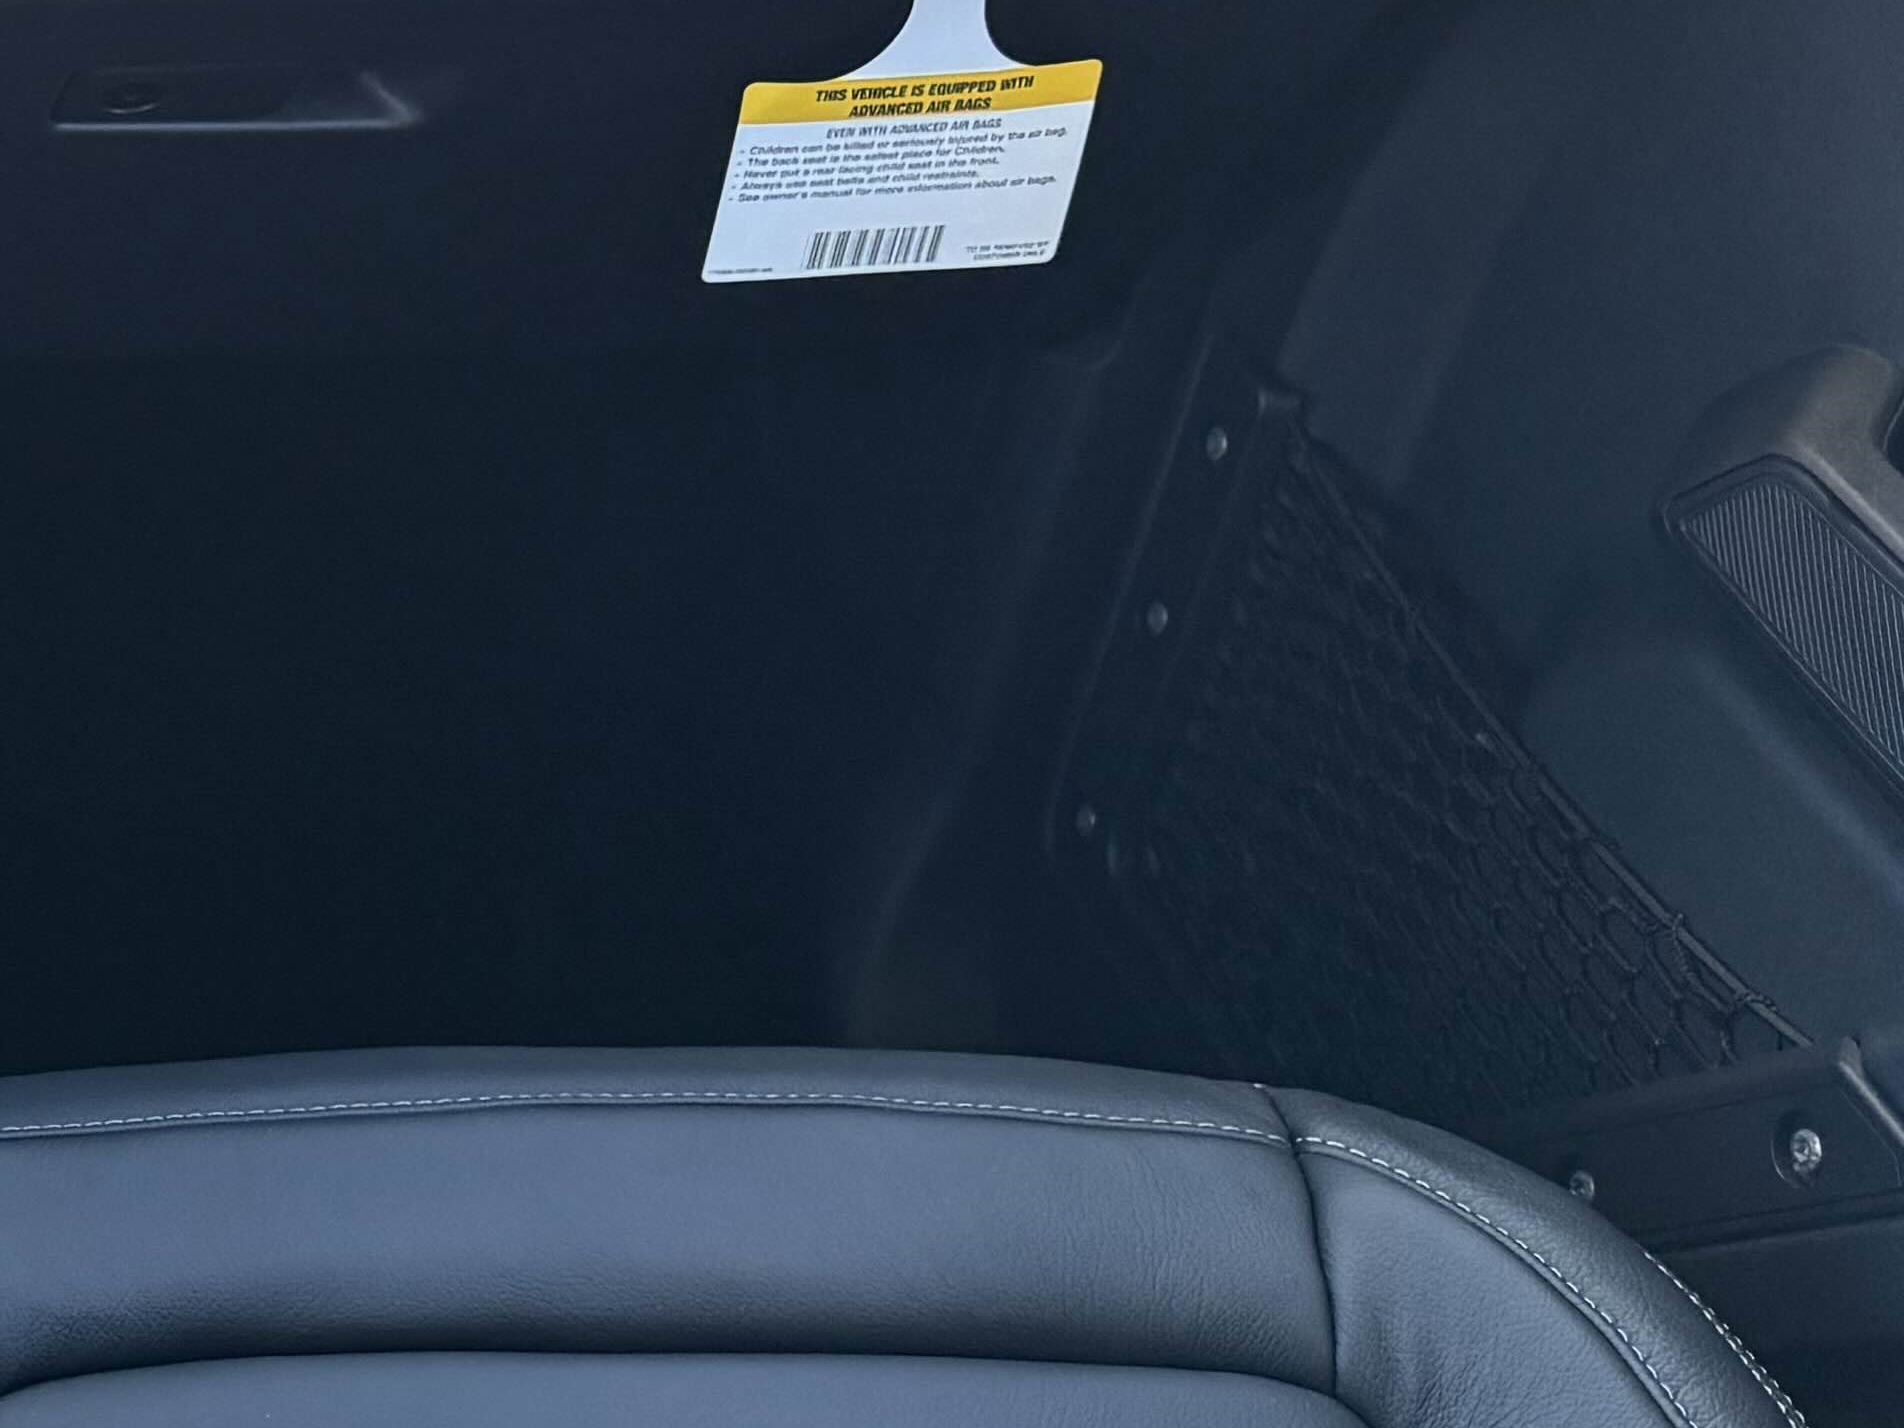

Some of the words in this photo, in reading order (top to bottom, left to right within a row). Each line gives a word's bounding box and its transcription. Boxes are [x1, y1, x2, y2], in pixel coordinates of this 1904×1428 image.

[815, 88, 847, 102] THIS
[851, 85, 908, 100] VEHICLE
[911, 83, 925, 97] IS
[929, 79, 996, 96] EQUIPPED
[1000, 75, 1034, 91] WITH
[848, 100, 923, 118] ADVANCED
[925, 99, 950, 113] AIR
[955, 97, 992, 112] BAGS
[826, 127, 855, 139] EVEN
[859, 125, 887, 137] WITH
[890, 122, 947, 134] ADVANCED
[951, 121, 969, 131] AIR
[973, 118, 1002, 130] BAGS
